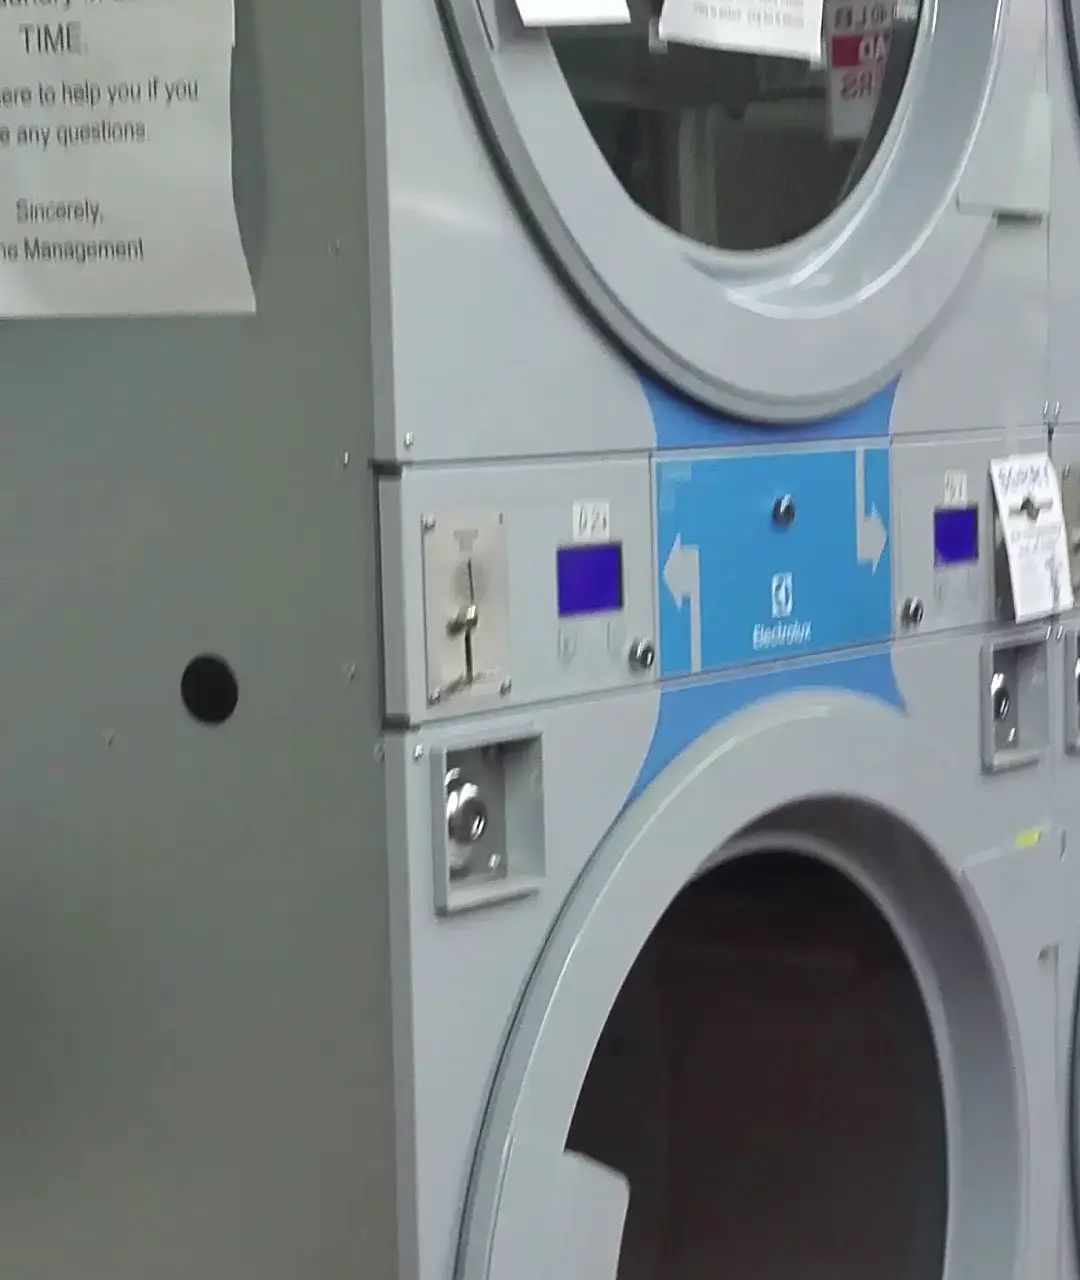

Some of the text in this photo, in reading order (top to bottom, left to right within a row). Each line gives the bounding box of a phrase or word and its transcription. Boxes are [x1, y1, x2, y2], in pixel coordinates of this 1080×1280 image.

[38, 81, 56, 107] to
[62, 78, 101, 110] help
[107, 82, 142, 108] you
[148, 76, 160, 102] if
[165, 79, 200, 109] you
[17, 124, 51, 152] any
[16, 196, 104, 230] Sincerely,
[24, 236, 144, 269] Management
